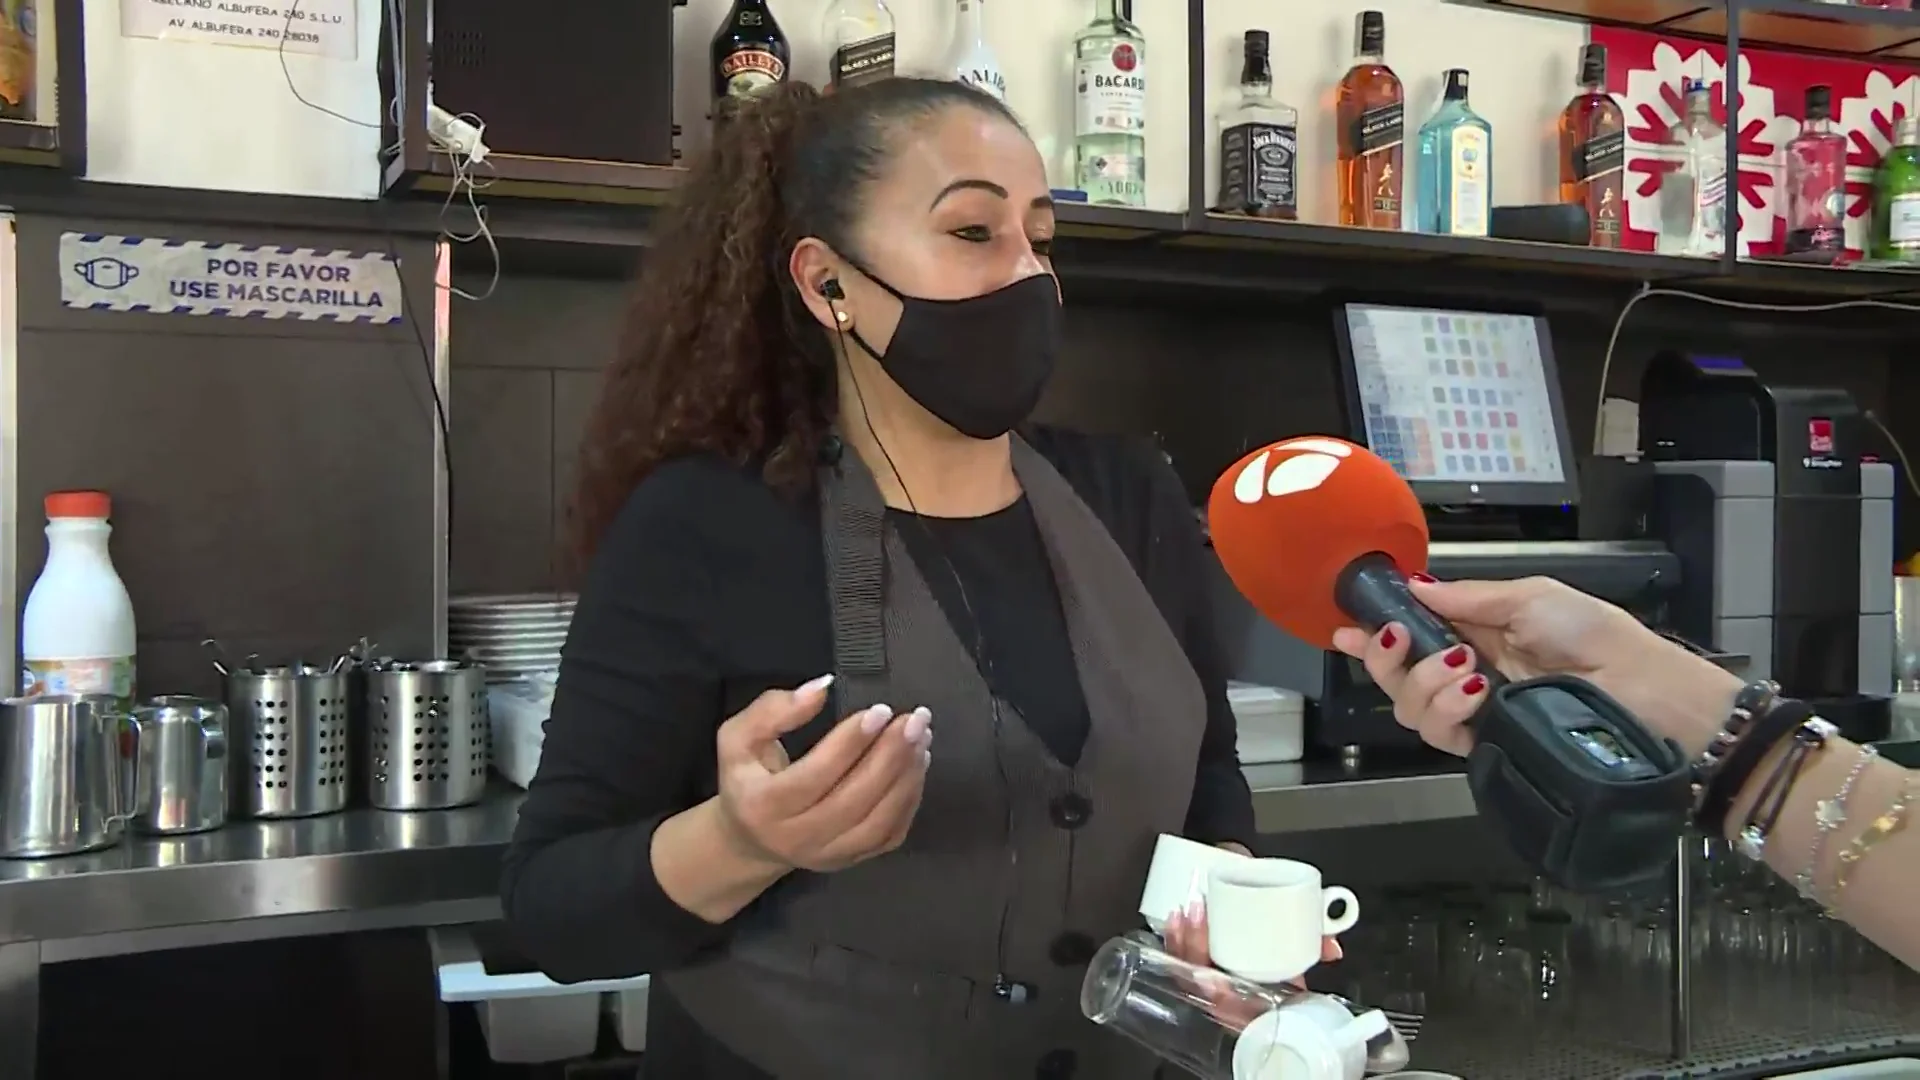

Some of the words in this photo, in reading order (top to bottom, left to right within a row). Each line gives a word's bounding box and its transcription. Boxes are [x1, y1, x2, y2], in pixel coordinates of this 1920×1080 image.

[217, 3, 278, 17] ALBUFERA
[283, 9, 306, 20] 240
[192, 20, 254, 37] ALBUFERA
[258, 28, 281, 39] 240
[207, 258, 258, 278] POR
[266, 262, 351, 283] FAVOR
[169, 279, 219, 300] USE
[227, 283, 383, 308] MASCARILLA
